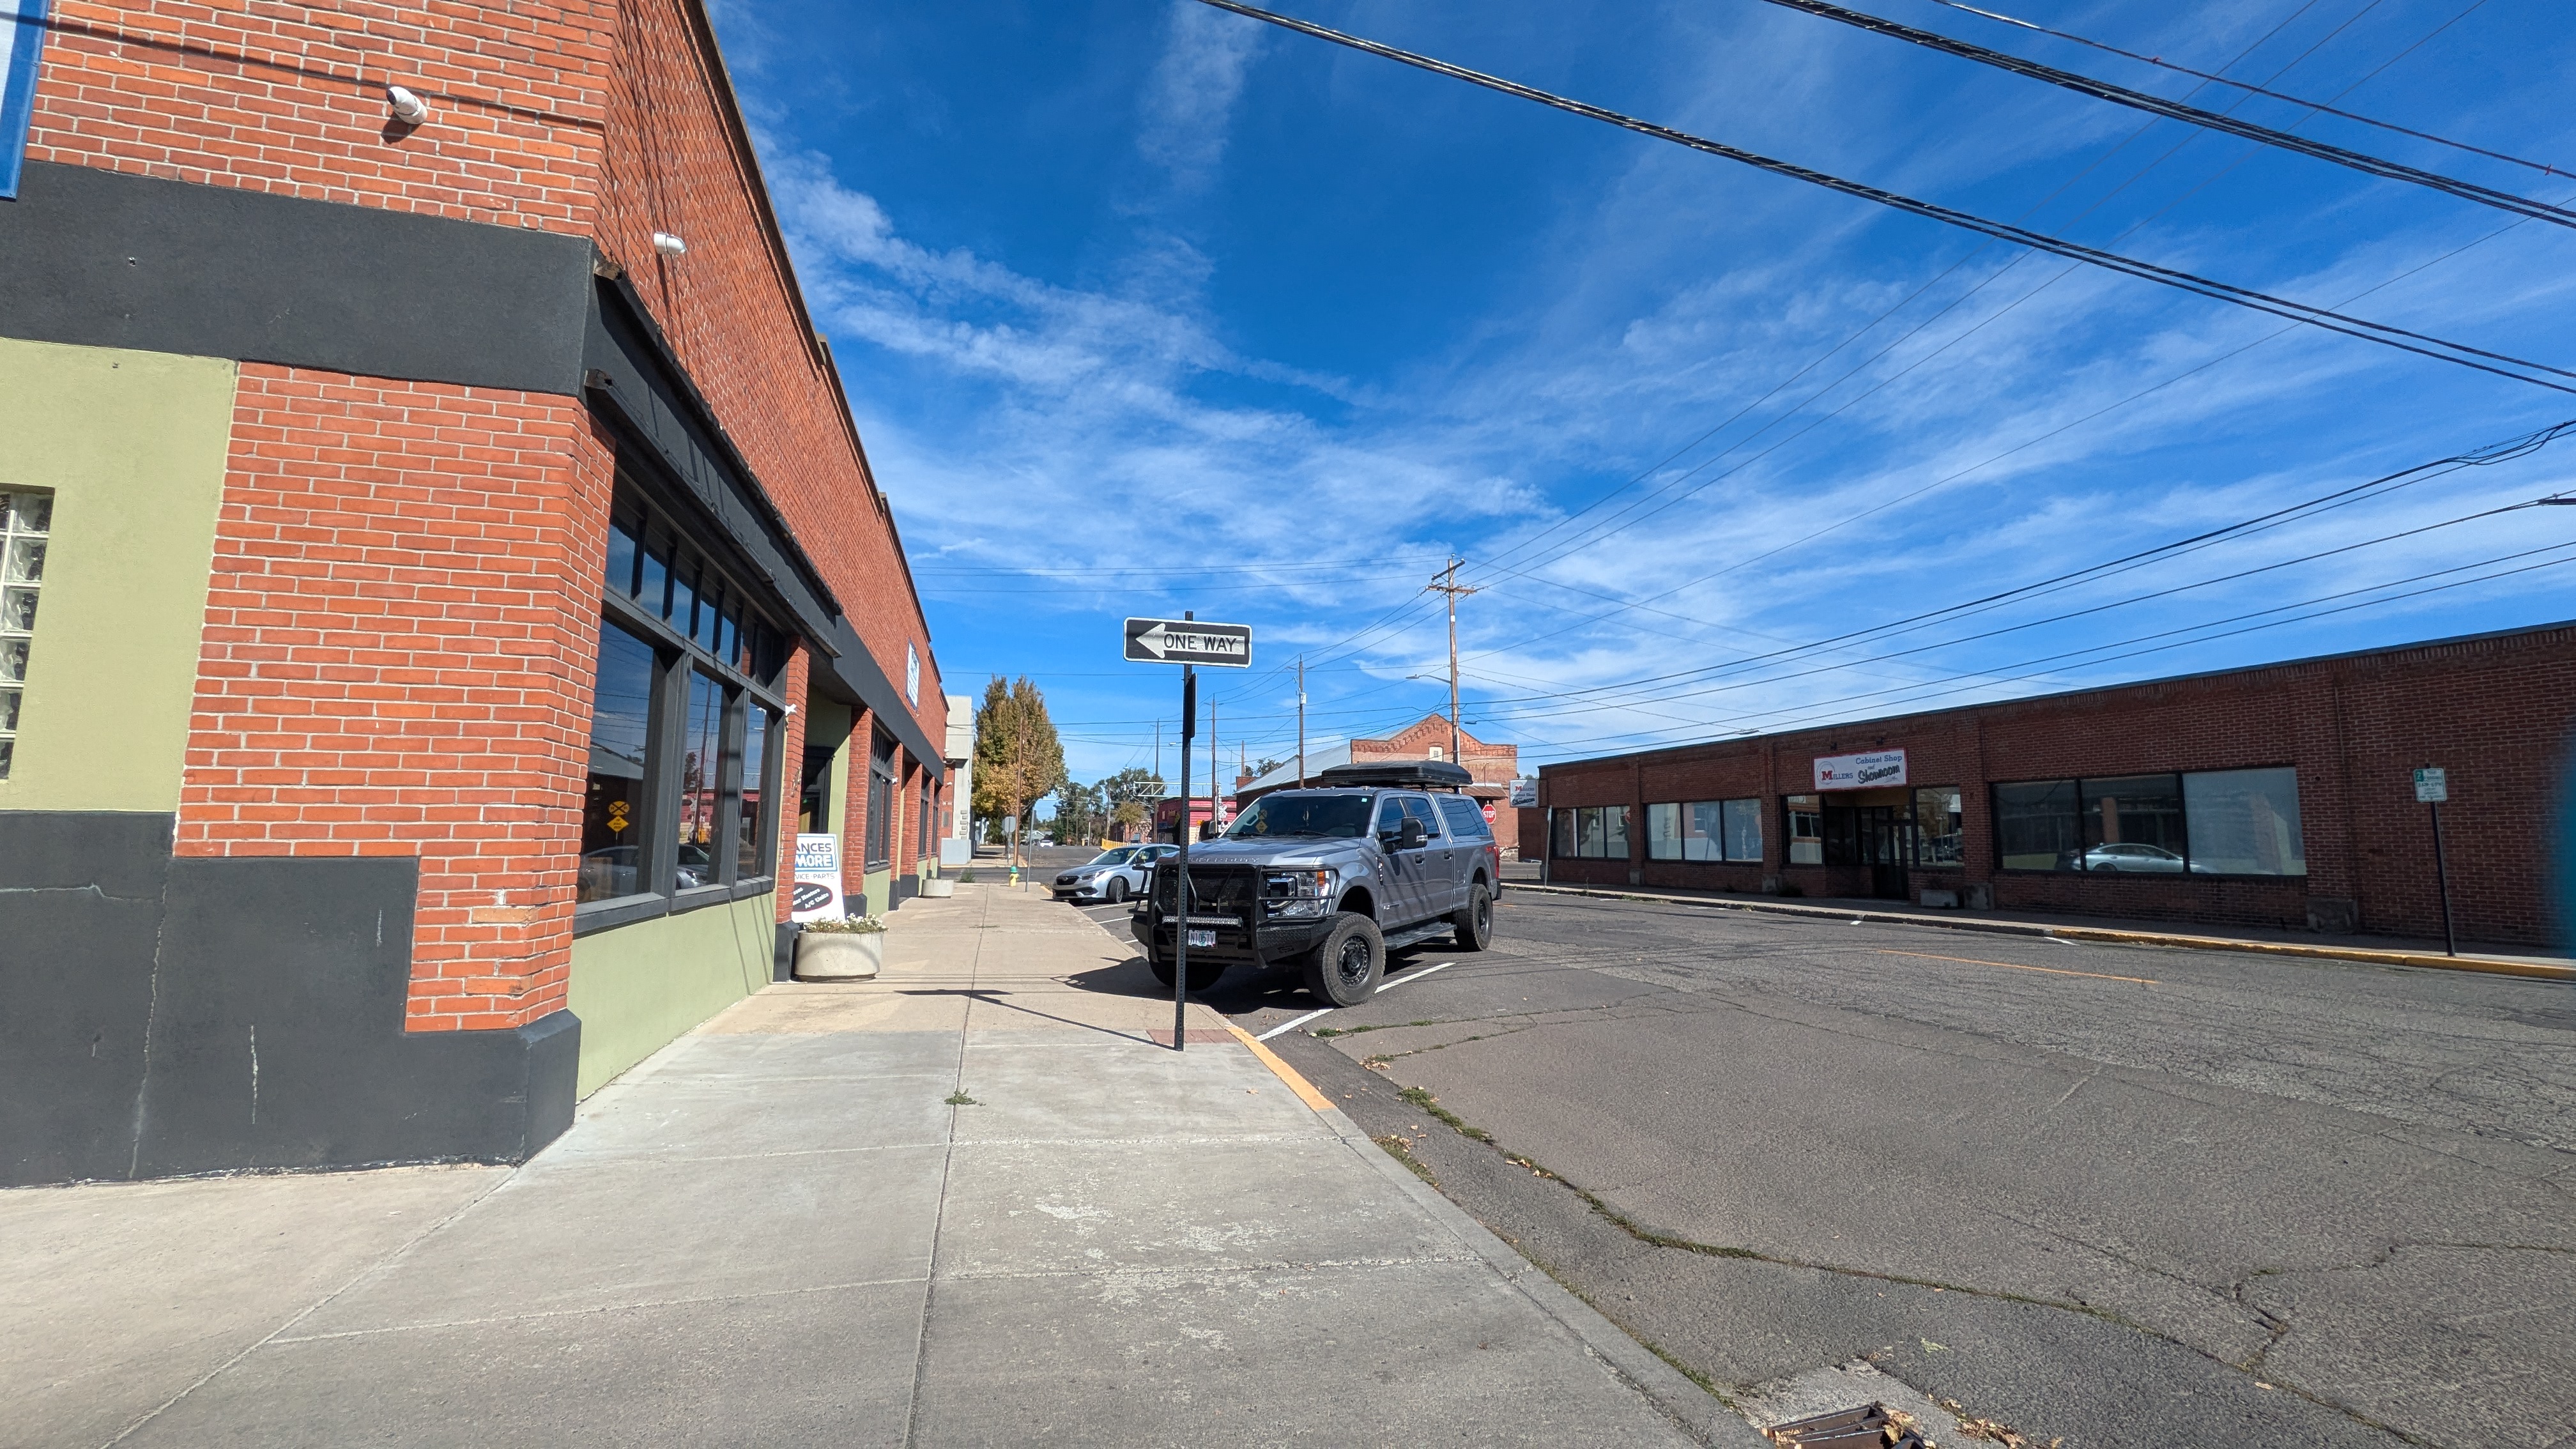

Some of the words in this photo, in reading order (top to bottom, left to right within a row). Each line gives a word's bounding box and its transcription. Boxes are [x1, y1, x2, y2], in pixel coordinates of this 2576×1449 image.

[1163, 633, 1197, 650] ONE
[1204, 636, 1237, 652] WAY
[1855, 756, 1882, 765] Cabinet
[1884, 755, 1903, 763] Shop
[1857, 764, 1901, 784] Showroom
[795, 855, 832, 867] MORE
